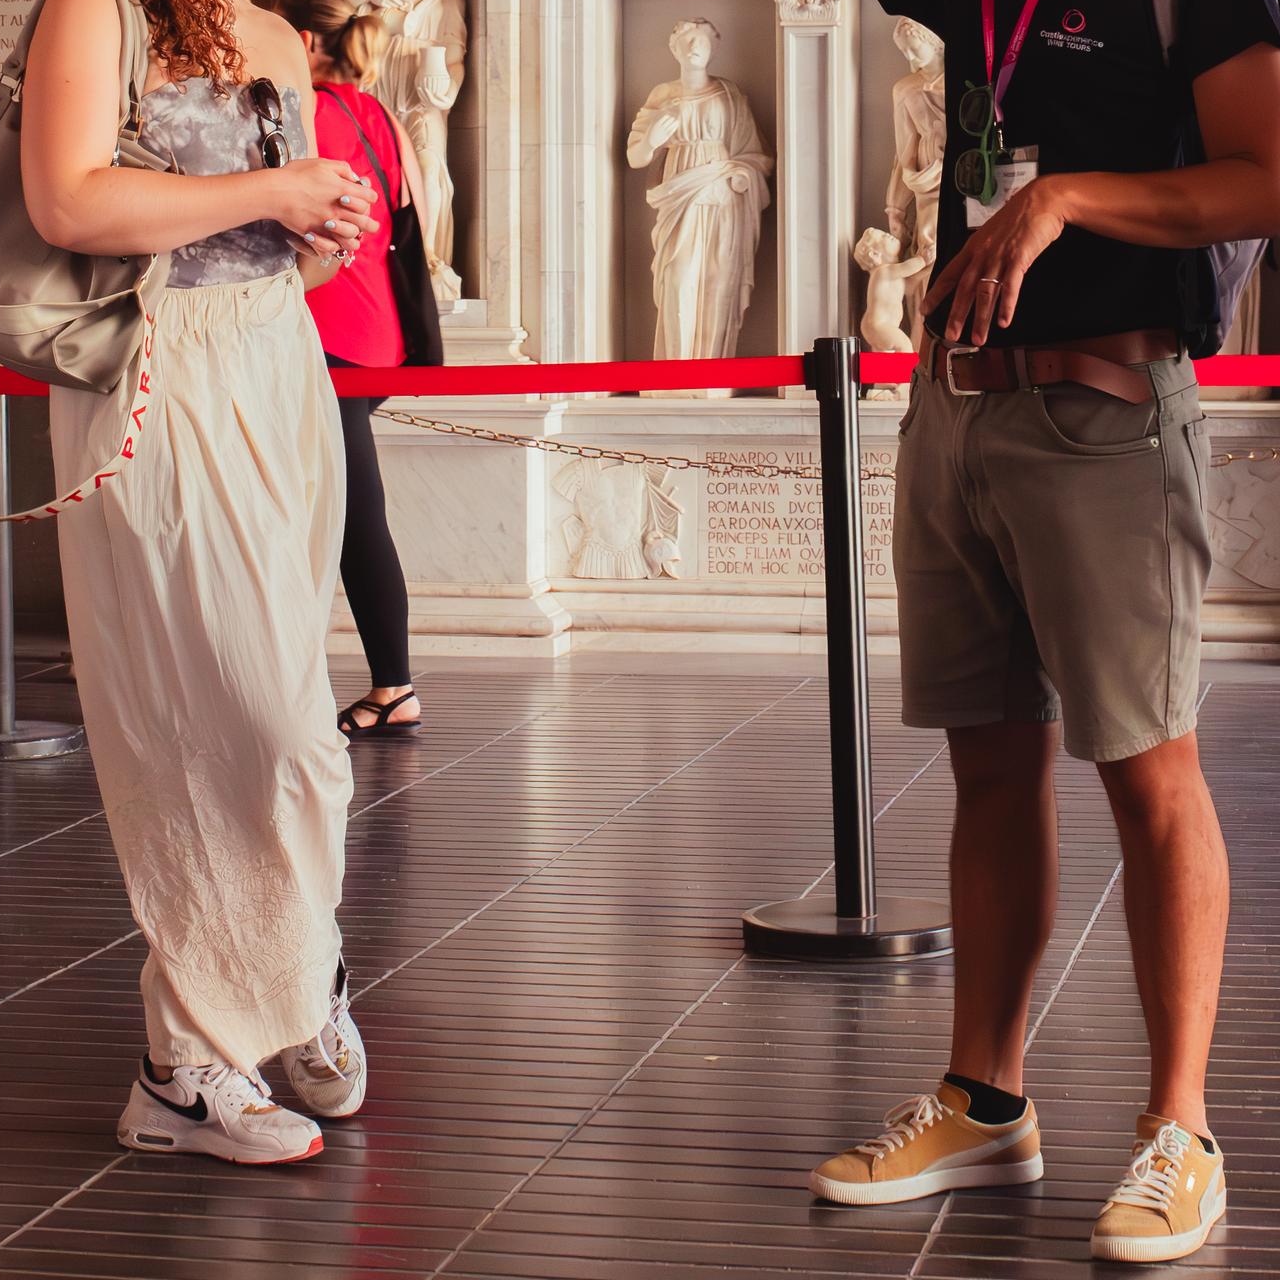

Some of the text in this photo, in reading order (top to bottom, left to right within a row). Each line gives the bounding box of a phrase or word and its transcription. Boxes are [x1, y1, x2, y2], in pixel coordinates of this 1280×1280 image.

[706, 451, 778, 464] BERNARDO
[785, 451, 821, 465] VILL
[707, 482, 779, 496] COPIARVM
[708, 501, 775, 514] ROMANIS
[708, 531, 768, 544] PRINCEPS
[778, 533, 811, 545] FILIA
[708, 546, 736, 559] EIVS
[745, 547, 791, 560] FILIAM
[708, 560, 754, 575] EODEM
[761, 561, 789, 575] HOC
